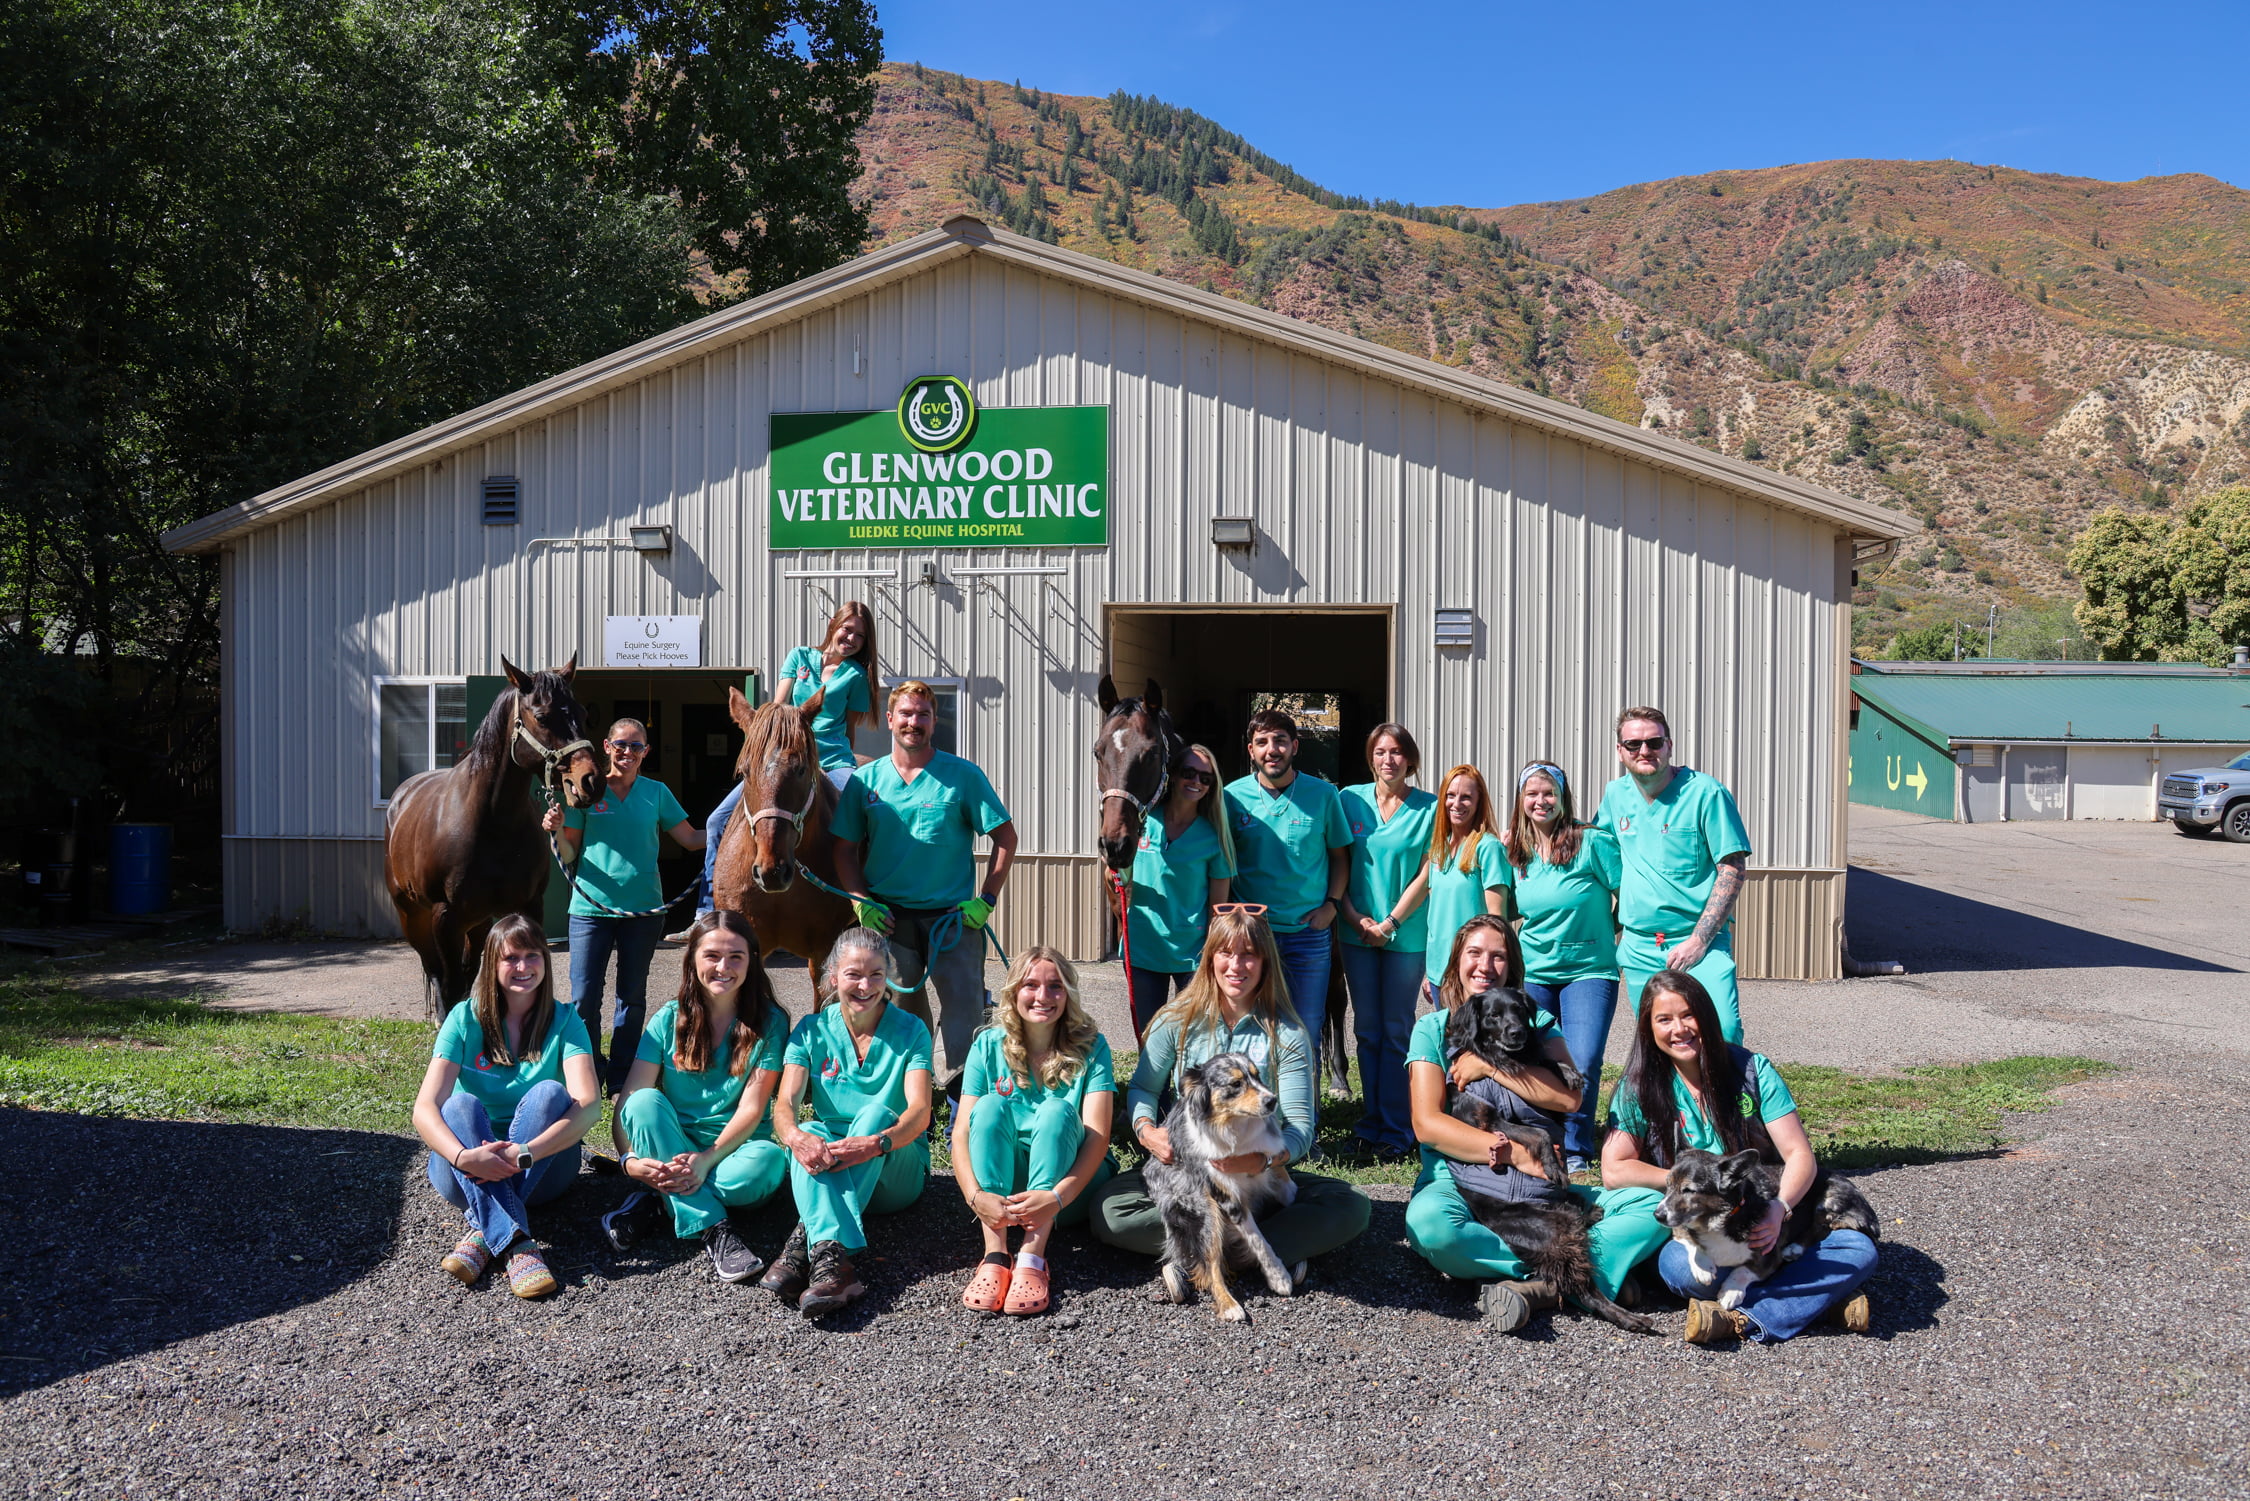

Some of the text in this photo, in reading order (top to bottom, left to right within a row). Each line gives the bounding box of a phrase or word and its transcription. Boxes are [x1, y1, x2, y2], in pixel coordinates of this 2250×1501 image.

[920, 402, 951, 415] GVC
[822, 448, 1053, 484] GLENWOOD
[777, 483, 1101, 522] VETERINARY CLINIC
[849, 523, 1025, 540] LUEDKE EQUINE HOSPITAL
[624, 641, 680, 650] Equine Surgery
[616, 652, 688, 660] Please Pick Hooves
